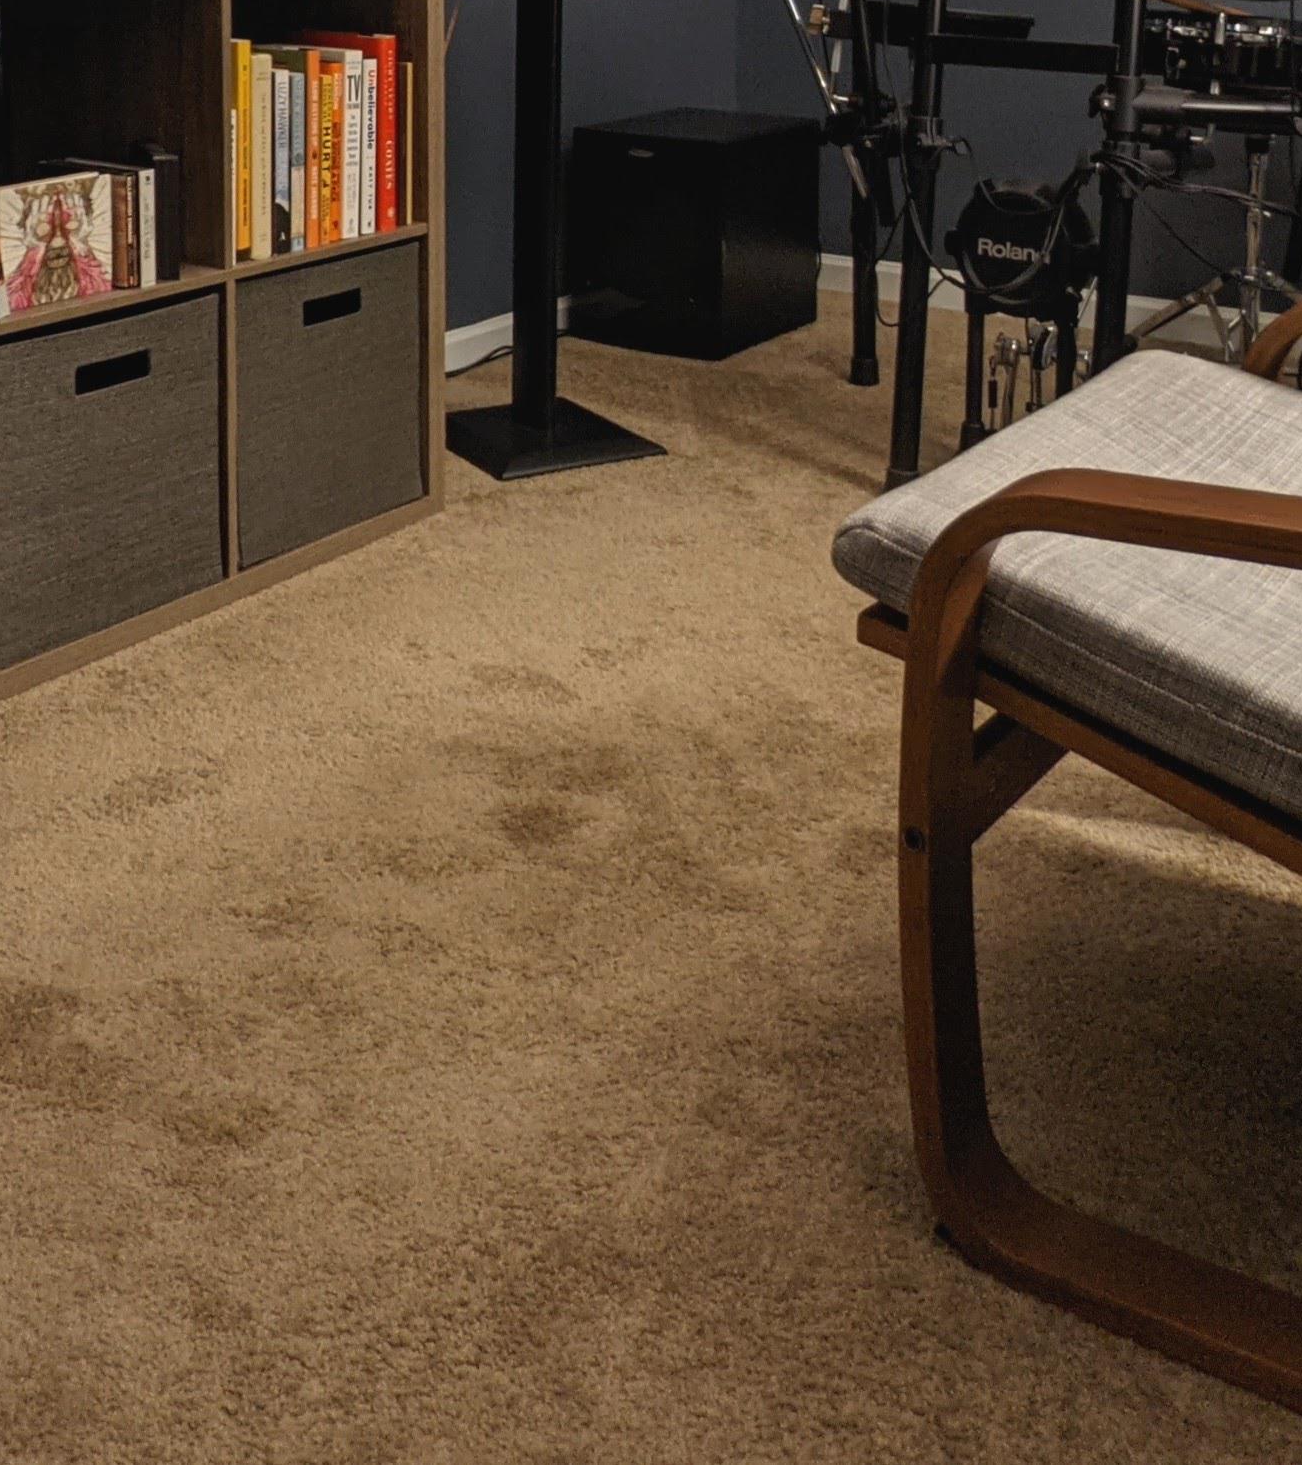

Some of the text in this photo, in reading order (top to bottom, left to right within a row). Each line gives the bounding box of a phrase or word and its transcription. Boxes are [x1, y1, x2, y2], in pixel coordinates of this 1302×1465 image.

[278, 82, 288, 149] LIZZY HAWKER
[347, 74, 360, 102] TV
[367, 69, 376, 150] Unbelievable
[322, 125, 331, 172] HURT
